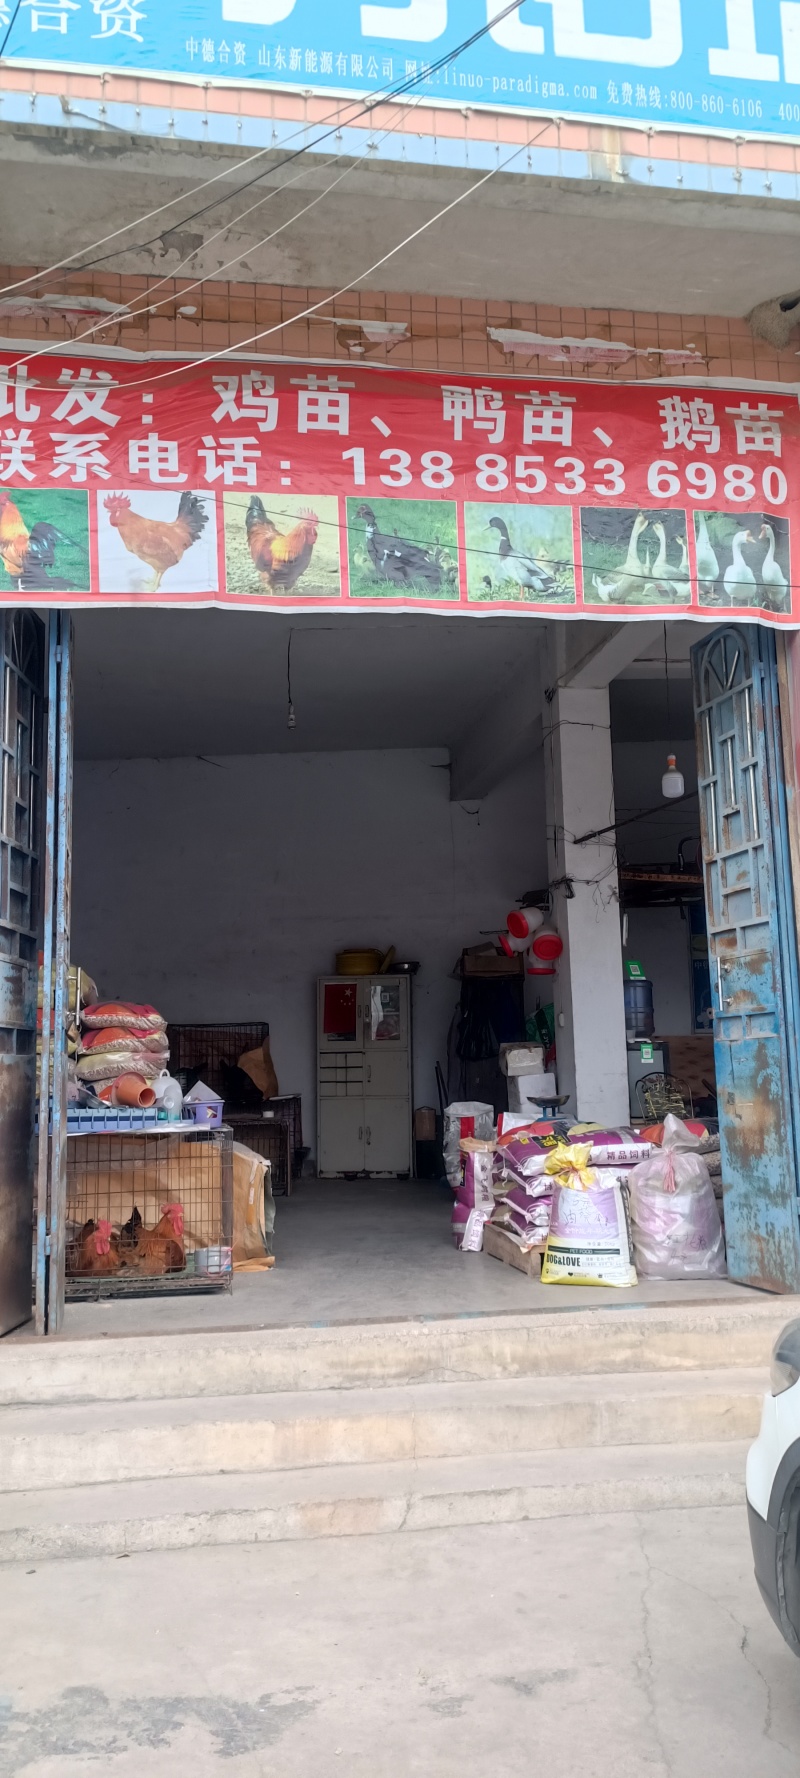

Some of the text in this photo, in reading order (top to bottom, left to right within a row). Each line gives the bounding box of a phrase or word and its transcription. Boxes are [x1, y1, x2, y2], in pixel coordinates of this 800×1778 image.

[185, 36, 247, 66] 中德合资
[258, 43, 394, 81] 山东新能源有限公司
[342, 447, 455, 489] 138
[475, 453, 627, 496] 8533
[647, 460, 788, 505] 6980
[606, 1149, 650, 1161] 精品饲料
